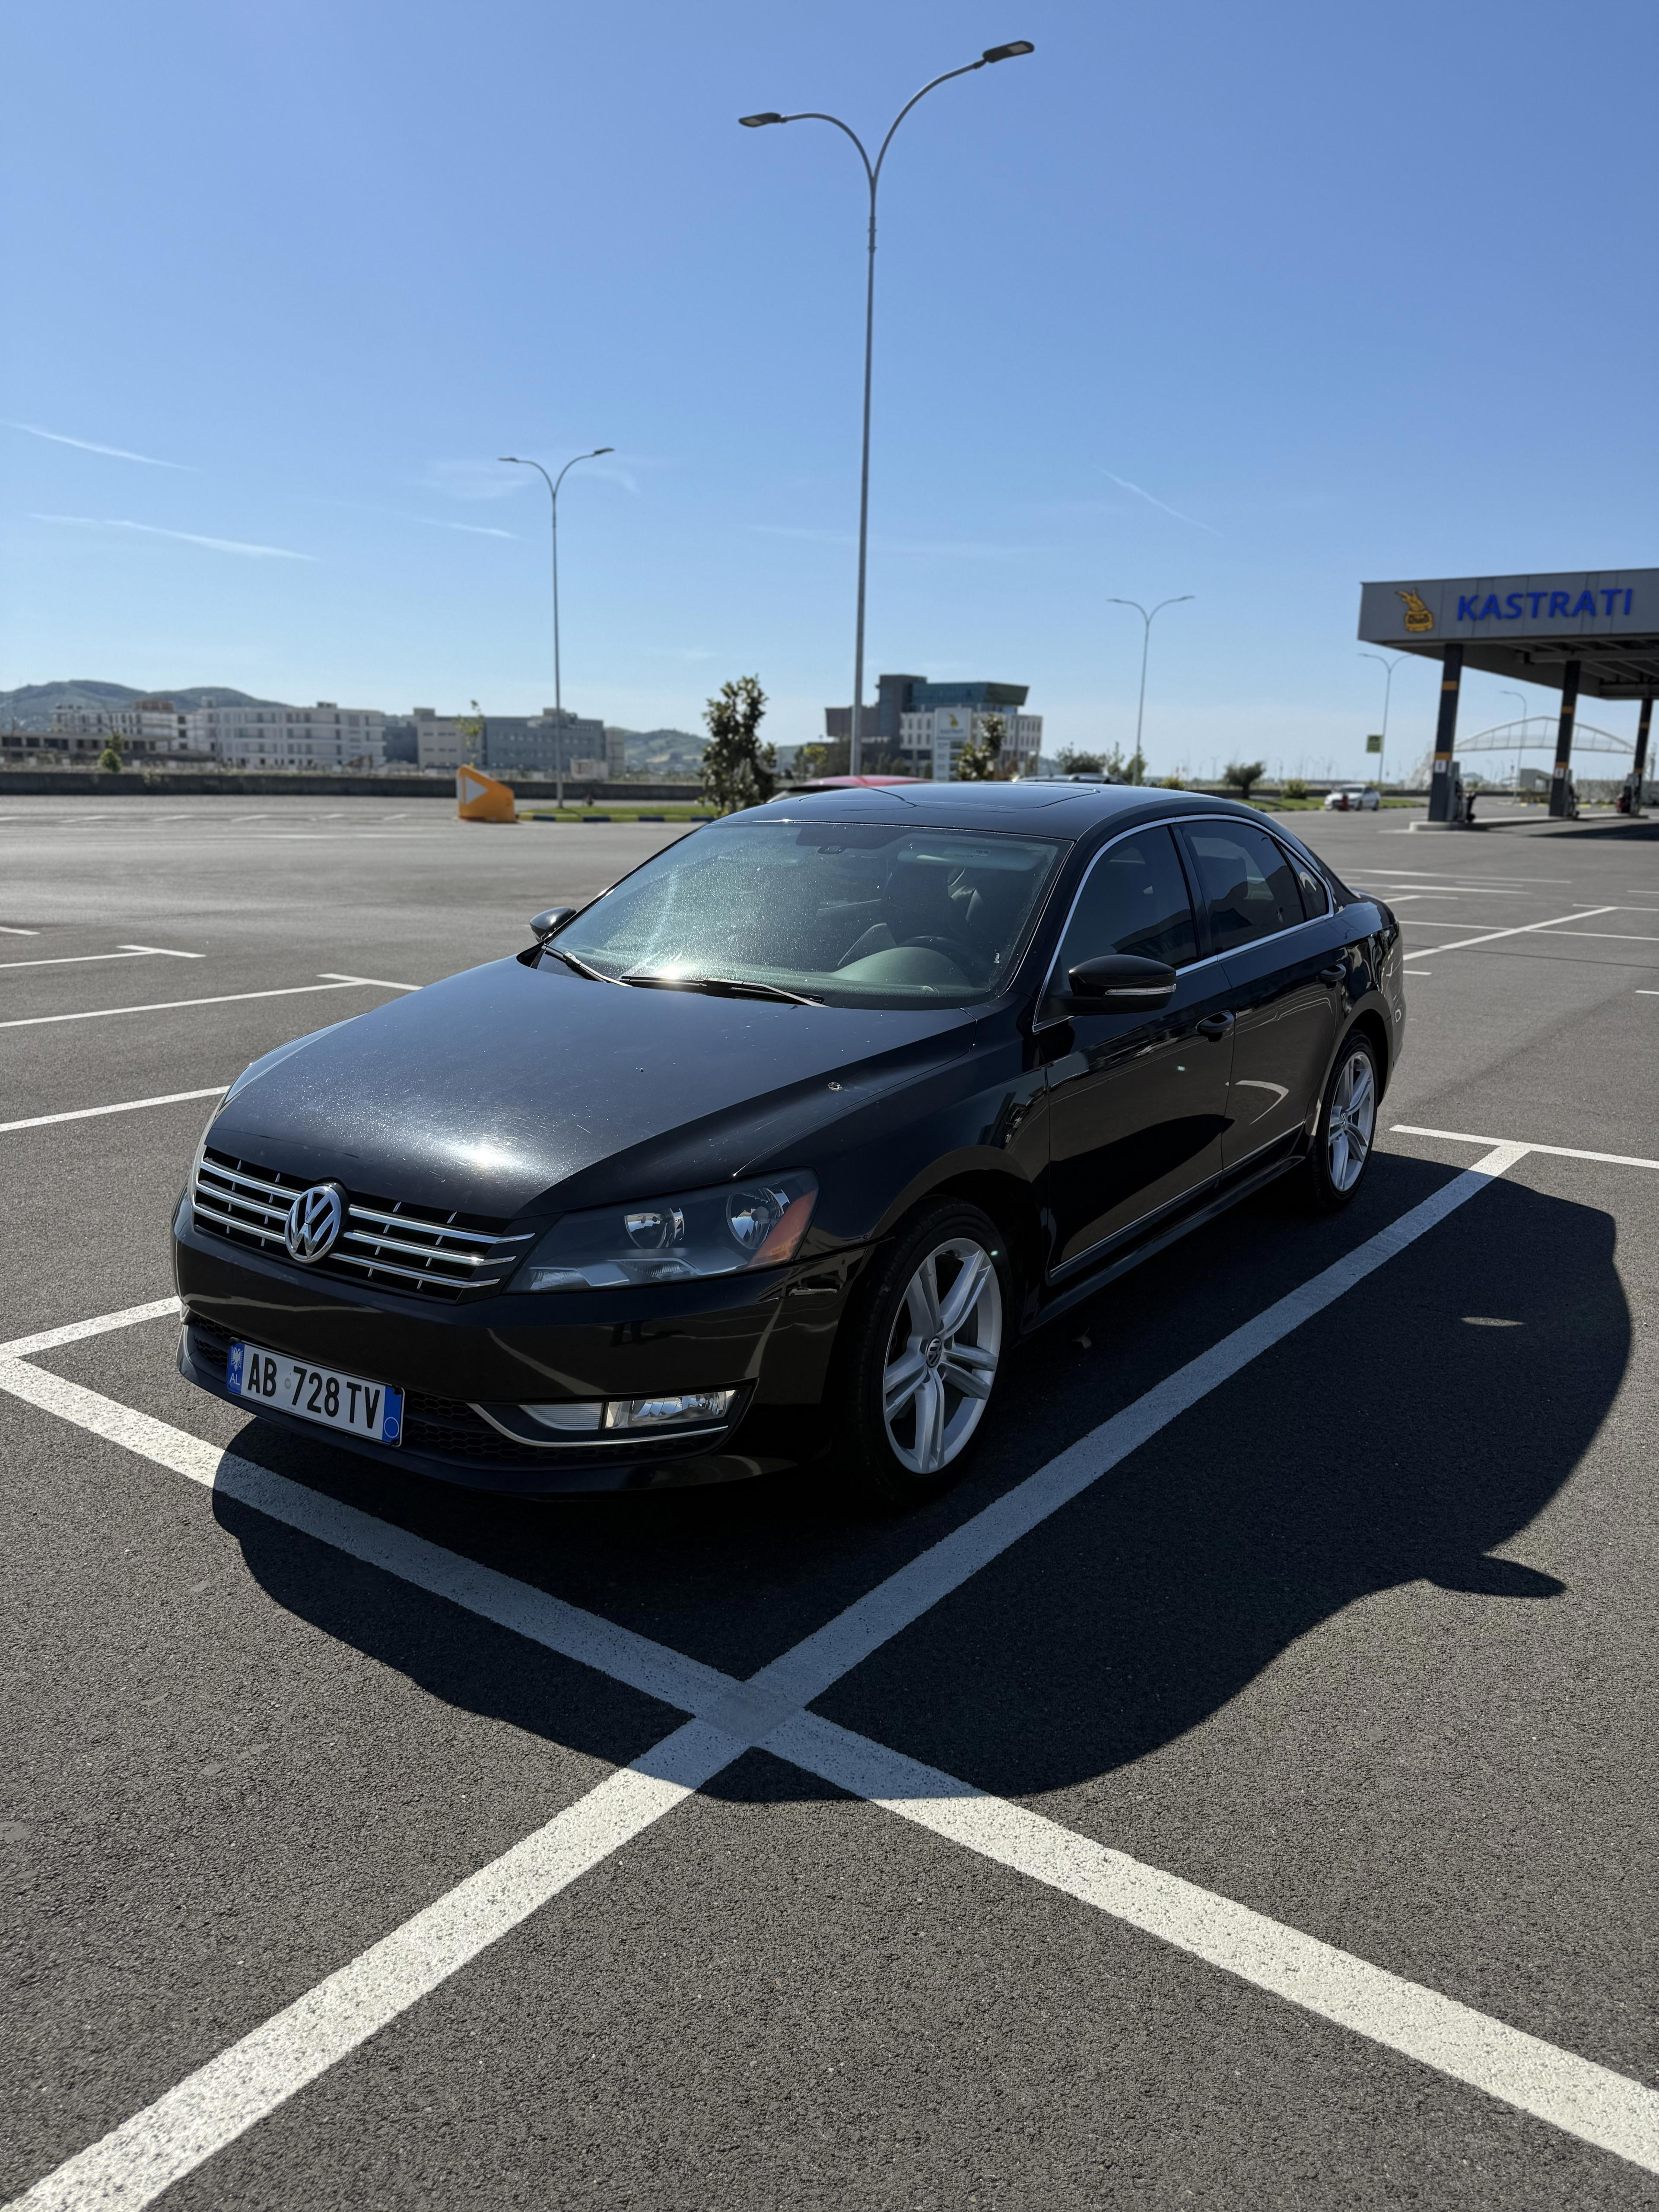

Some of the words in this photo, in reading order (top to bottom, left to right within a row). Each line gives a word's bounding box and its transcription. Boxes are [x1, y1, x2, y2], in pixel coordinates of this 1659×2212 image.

[1457, 588, 1633, 621] KASTRATI
[287, 1187, 341, 1259] VW
[229, 1373, 240, 1386] AL
[248, 1353, 277, 1397] AB
[292, 1366, 340, 1417] 728
[346, 1382, 380, 1429] TV
